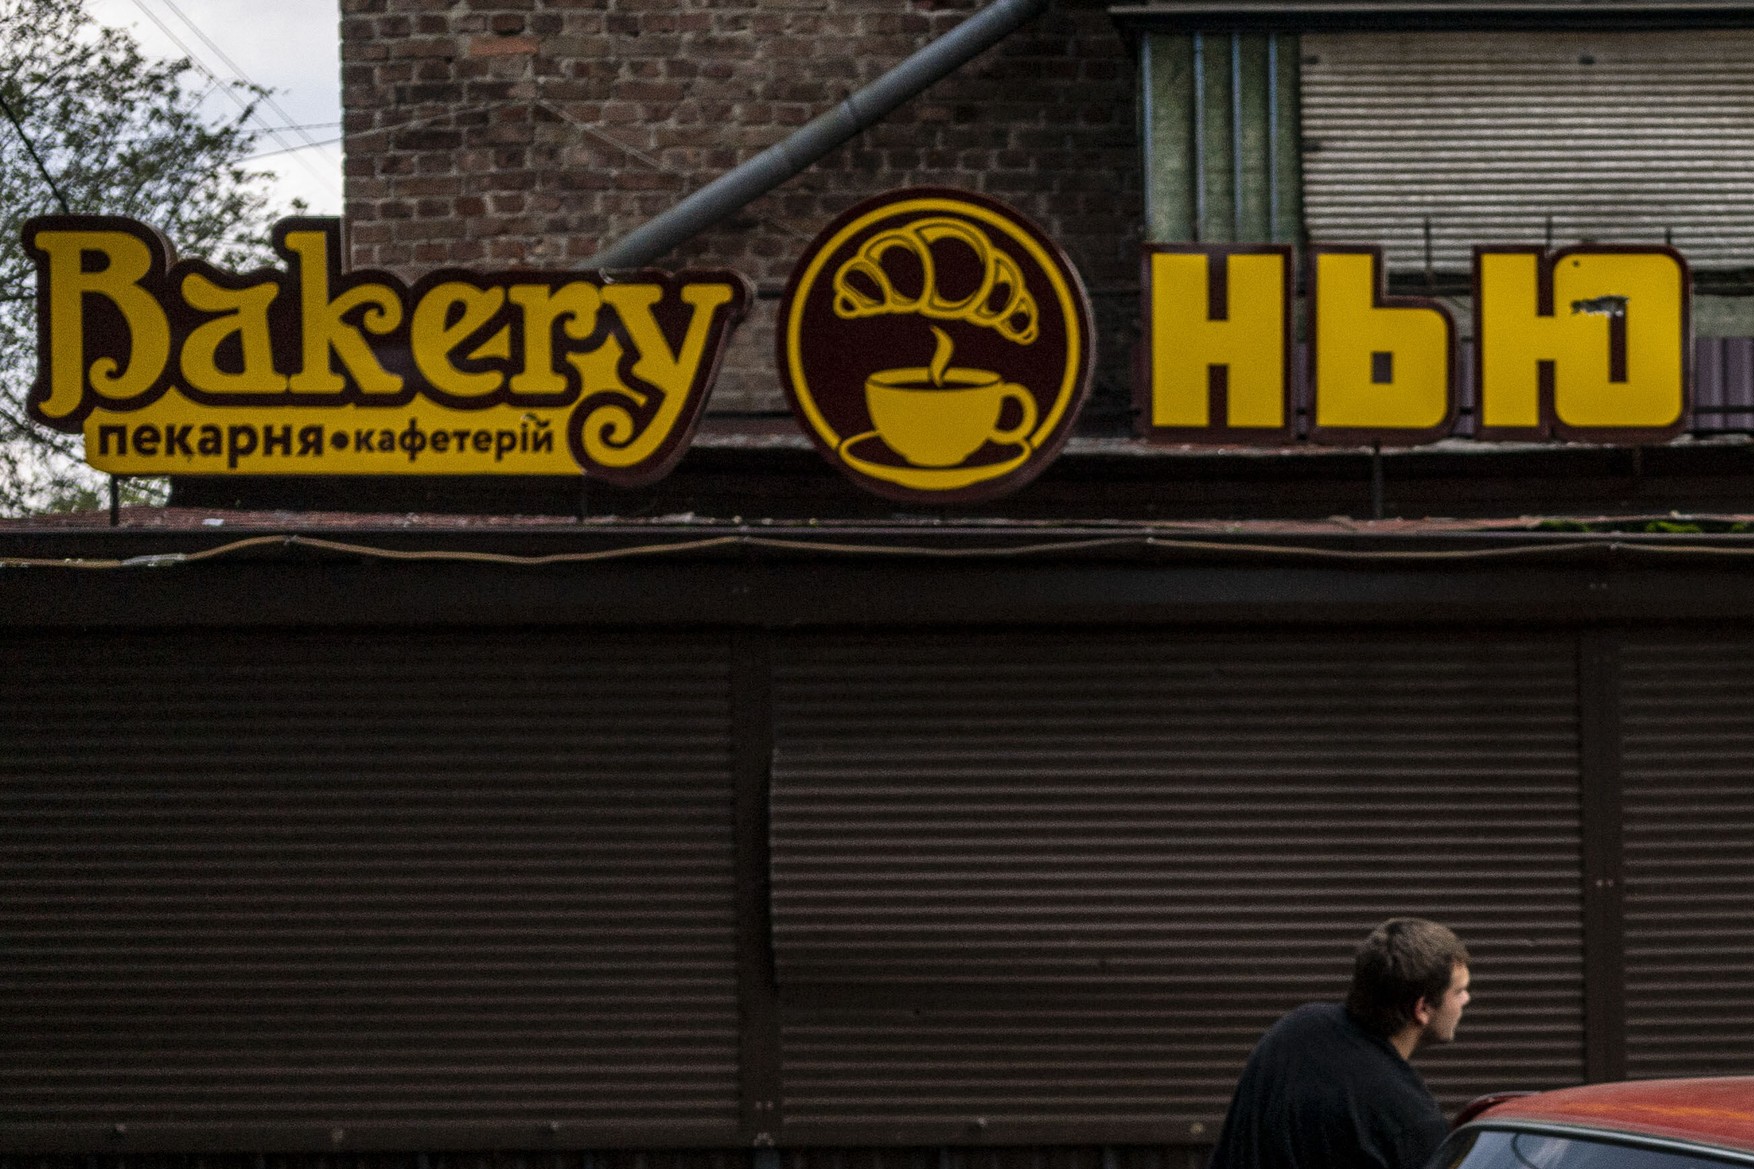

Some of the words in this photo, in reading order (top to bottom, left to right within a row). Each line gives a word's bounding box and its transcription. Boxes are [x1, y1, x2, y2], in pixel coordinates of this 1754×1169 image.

[36, 231, 733, 467] Bakery
[1150, 251, 1683, 429] НЬЮ
[99, 423, 324, 470] пекарня
